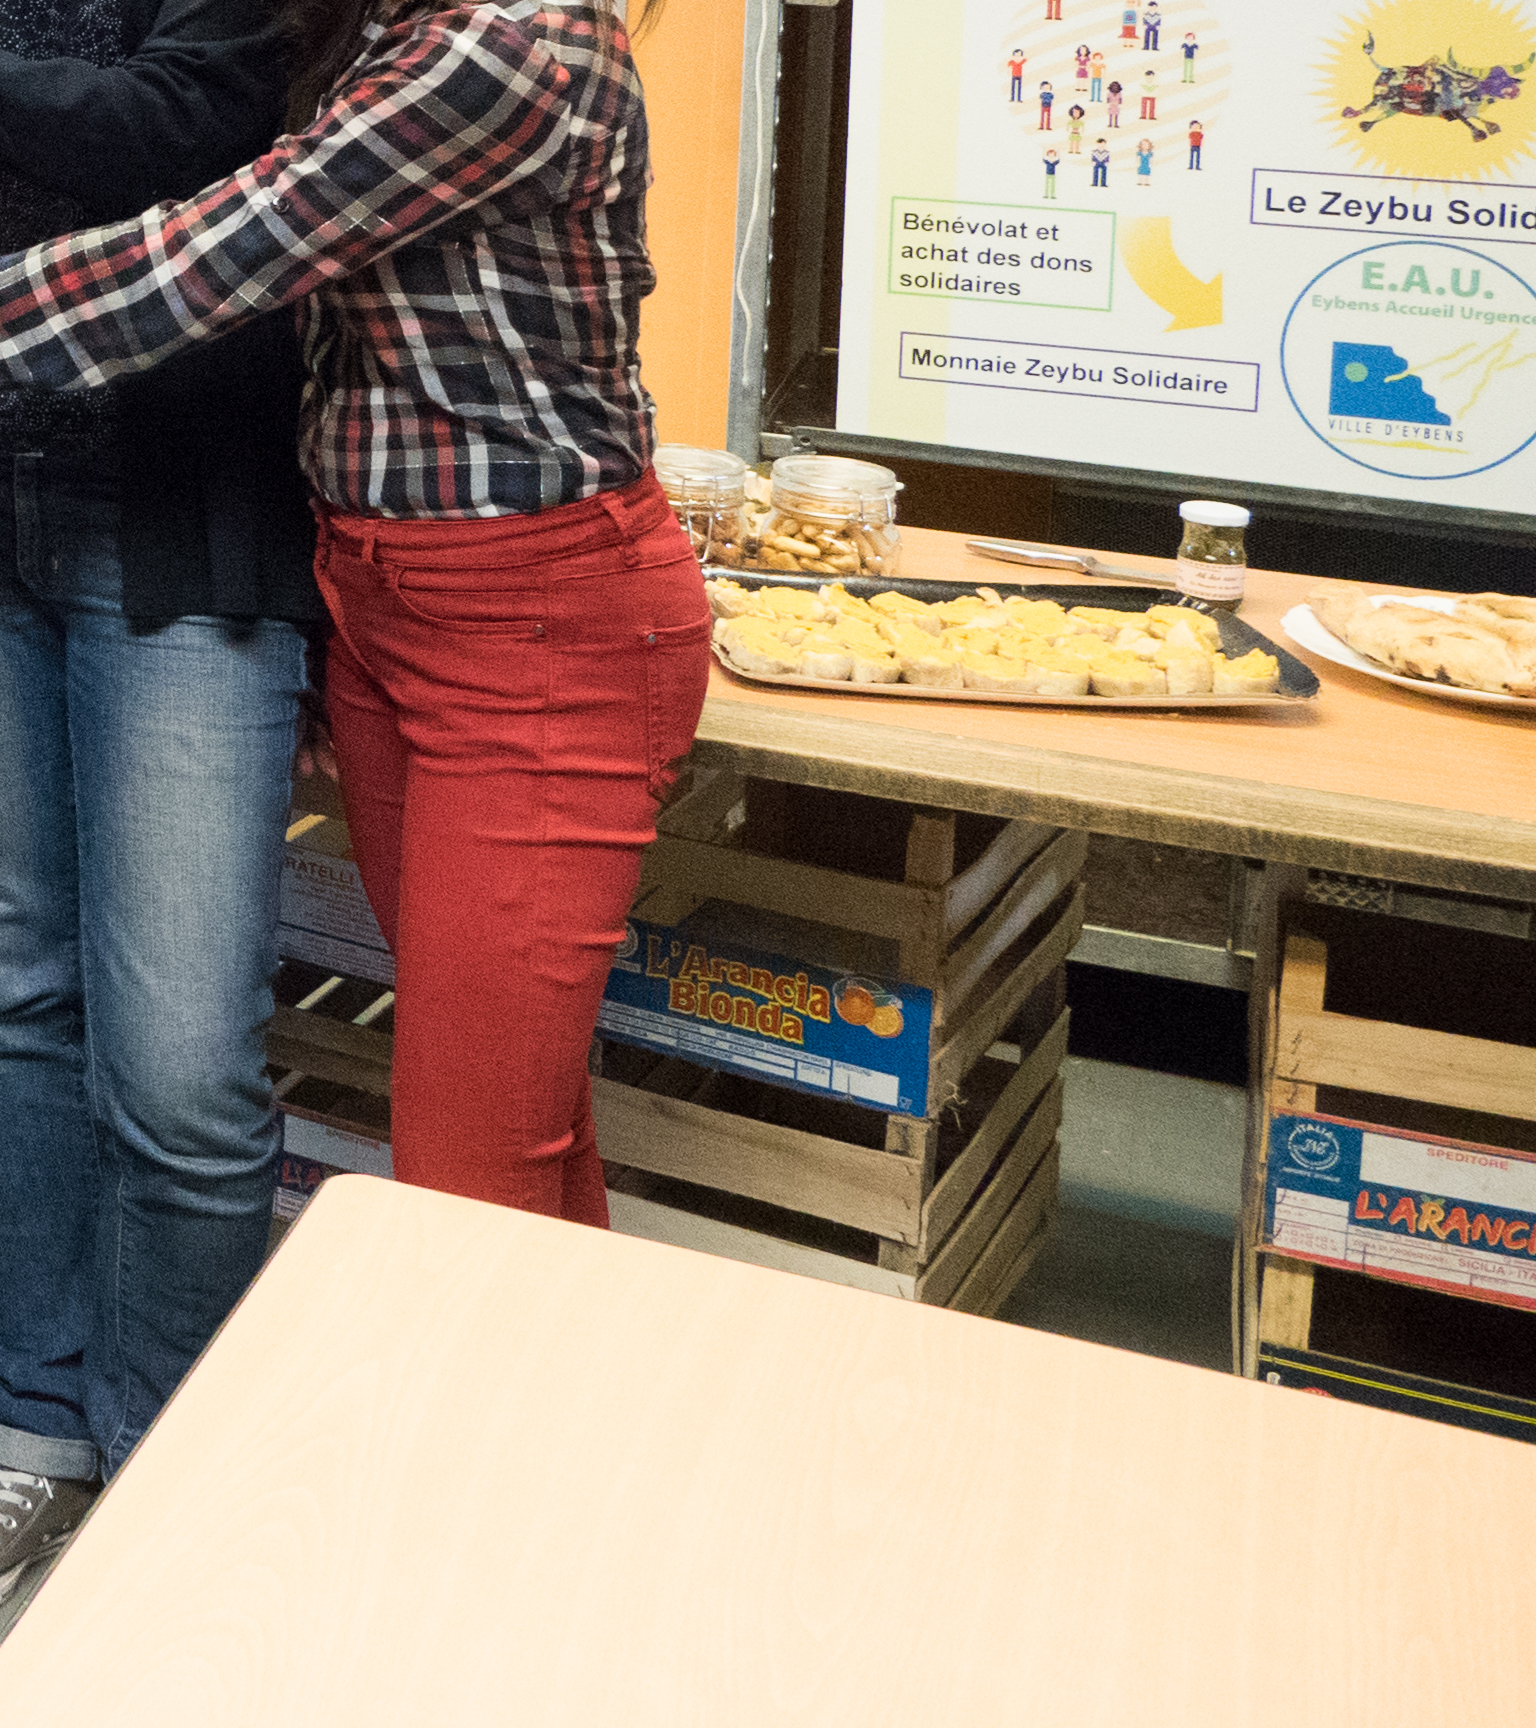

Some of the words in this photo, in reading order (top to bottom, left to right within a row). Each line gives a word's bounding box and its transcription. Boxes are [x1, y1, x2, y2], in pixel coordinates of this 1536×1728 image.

[1265, 187, 1307, 215] Le
[1318, 190, 1435, 226] Zeybu
[902, 212, 1029, 241] Bénévolat
[1035, 223, 1060, 242] et
[900, 242, 970, 265] achat
[977, 245, 1022, 268] des
[1029, 249, 1093, 274] dons
[899, 272, 1022, 298] solidaires
[1360, 260, 1496, 300] E.A.U.
[1311, 294, 1381, 318] Eybens
[1385, 298, 1455, 319] Accueil
[910, 347, 1018, 376] Monnaie
[1024, 355, 1105, 386] Zeybu
[1112, 364, 1229, 396] Solidaire
[1328, 418, 1375, 437] VILLE
[1384, 423, 1466, 444] D'EYBENS
[644, 934, 831, 1025] L'Arancia
[668, 977, 805, 1046] Bionda
[1426, 1146, 1510, 1172] SPEDITORE
